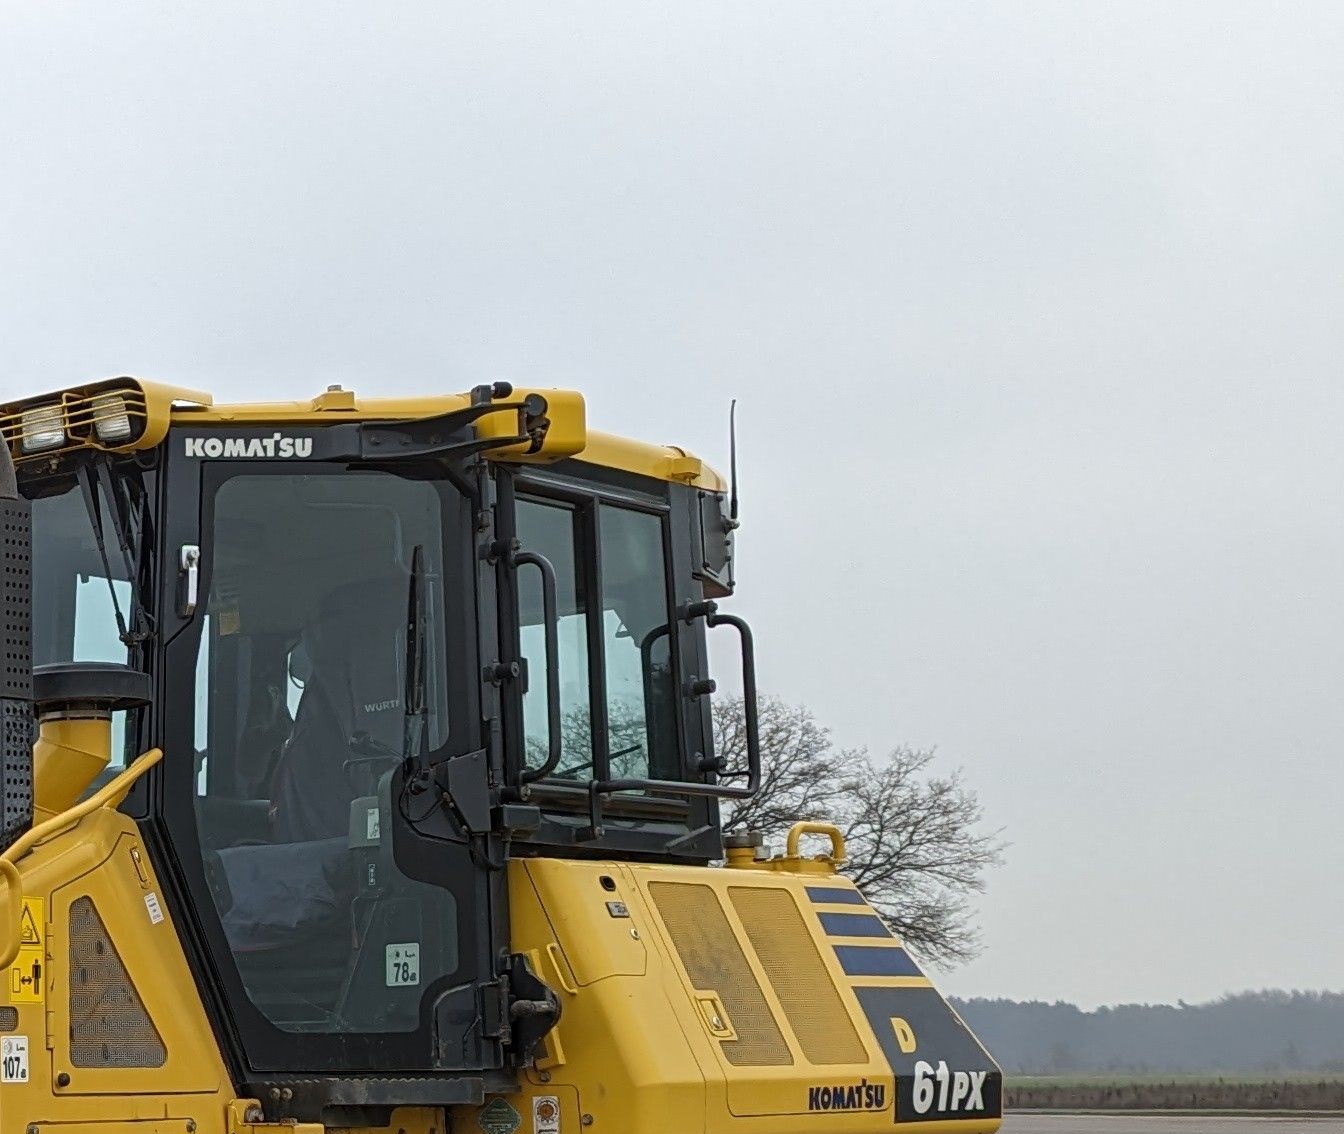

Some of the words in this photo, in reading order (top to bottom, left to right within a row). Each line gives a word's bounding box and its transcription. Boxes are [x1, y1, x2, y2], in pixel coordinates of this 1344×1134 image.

[185, 432, 312, 457] KOMATSU
[393, 961, 409, 982] 78
[889, 1017, 917, 1053] D
[3, 1056, 21, 1078] 107
[808, 1078, 885, 1110] KOMATSU
